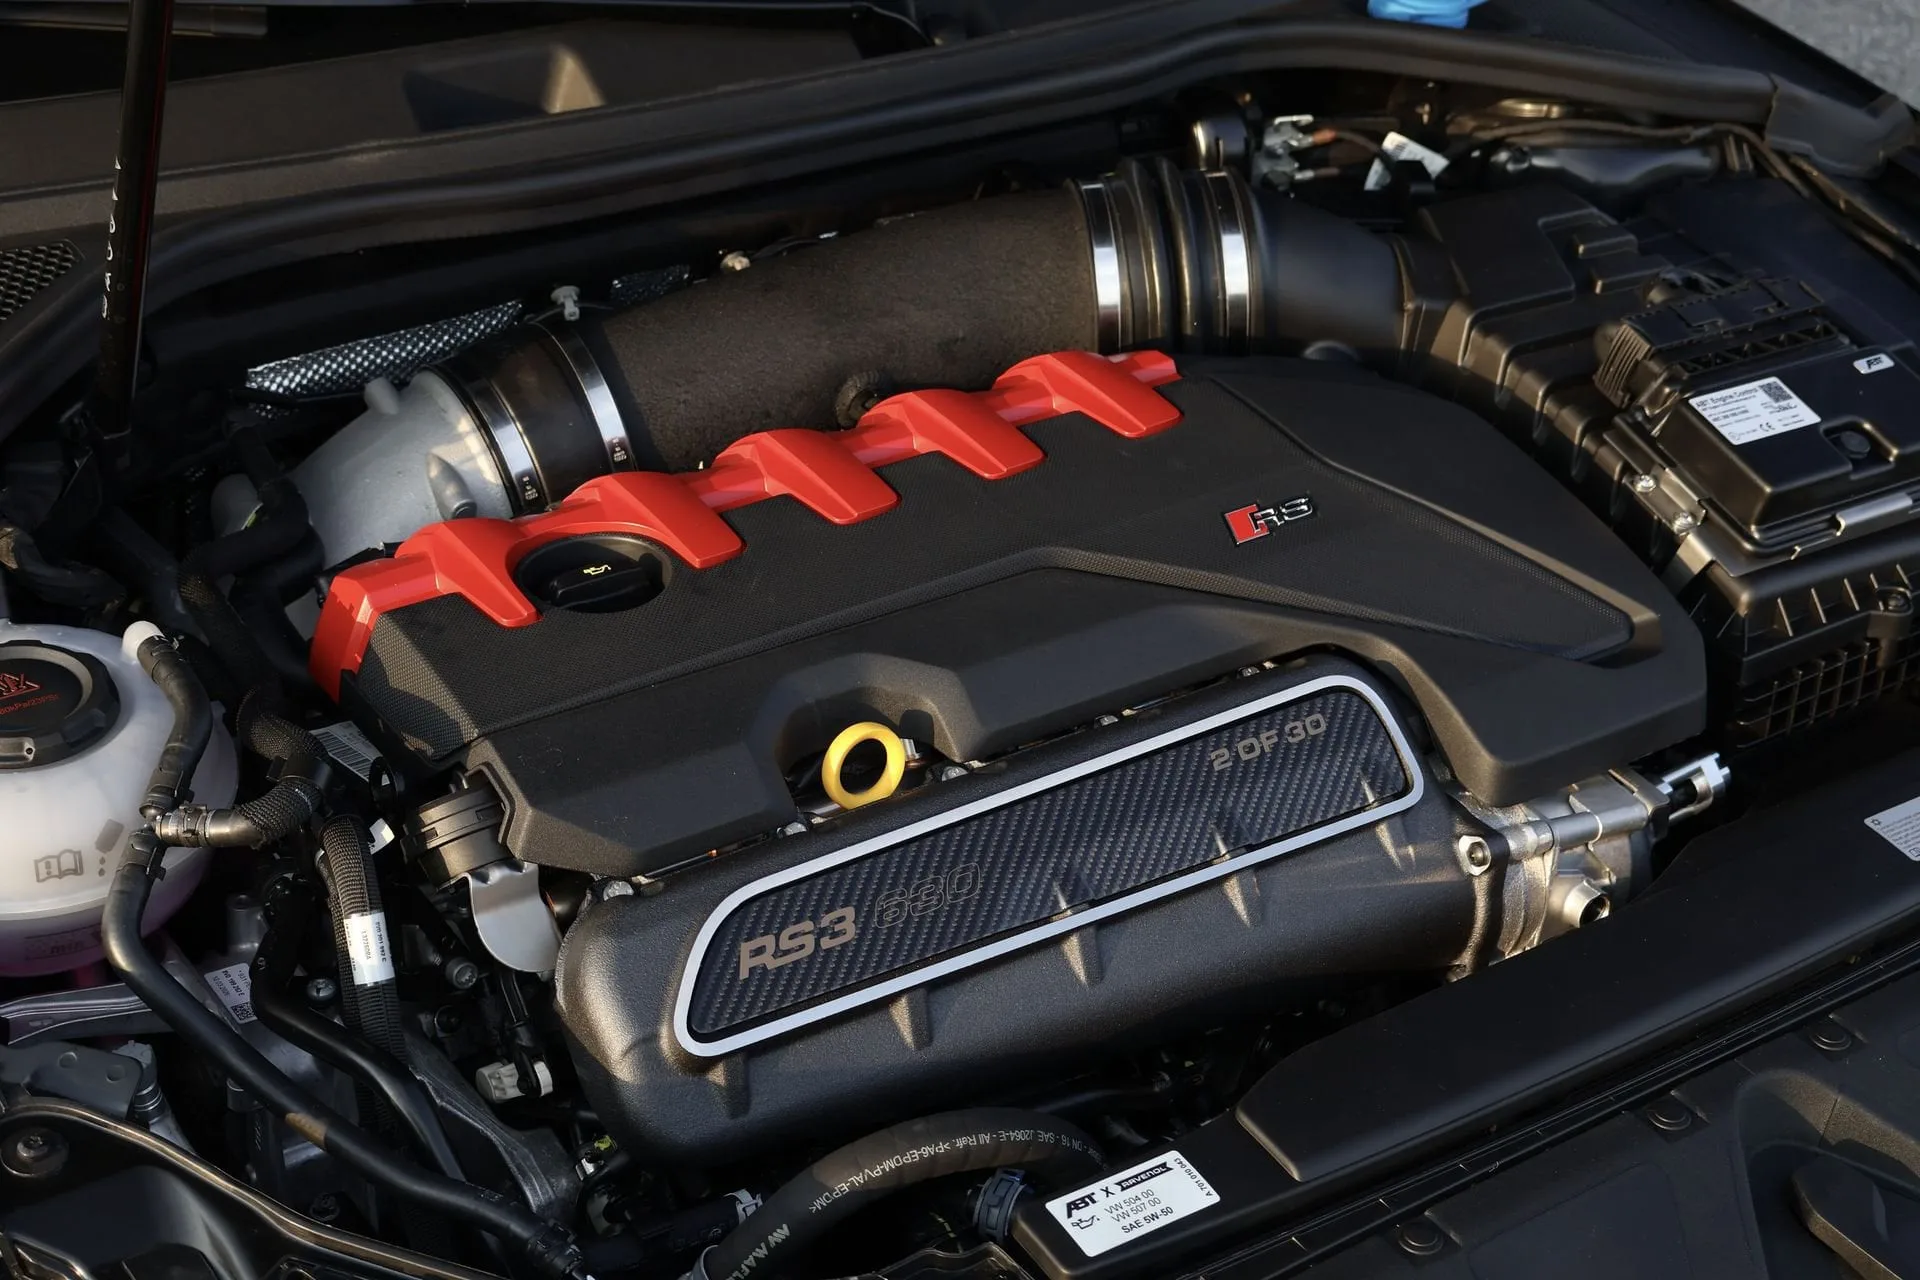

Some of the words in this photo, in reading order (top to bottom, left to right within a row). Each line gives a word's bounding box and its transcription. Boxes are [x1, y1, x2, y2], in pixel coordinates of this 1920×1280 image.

[1709, 394, 1734, 404] Engine
[1733, 387, 1758, 398] Control
[1210, 747, 1233, 772] 2
[1237, 729, 1279, 761] OF
[1284, 713, 1327, 744] 30
[739, 906, 856, 981] RS3
[875, 862, 981, 929] 630
[978, 1132, 991, 1145] All
[1037, 1130, 1055, 1144] SAE
[1174, 1157, 1187, 1169] 043
[1184, 1168, 1198, 1180] 010
[1066, 1192, 1098, 1219] ABT
[1120, 1165, 1168, 1188] RAVENOL
[1195, 1179, 1208, 1192] 701
[1104, 1202, 1123, 1214] VW
[1123, 1195, 1141, 1208] 504
[1141, 1188, 1155, 1199] 00
[1111, 1209, 1131, 1222] VW
[1130, 1203, 1148, 1215] 507
[1147, 1196, 1161, 1208] 00
[1121, 1219, 1145, 1234] SAE
[1143, 1206, 1175, 1224] 5W-50
